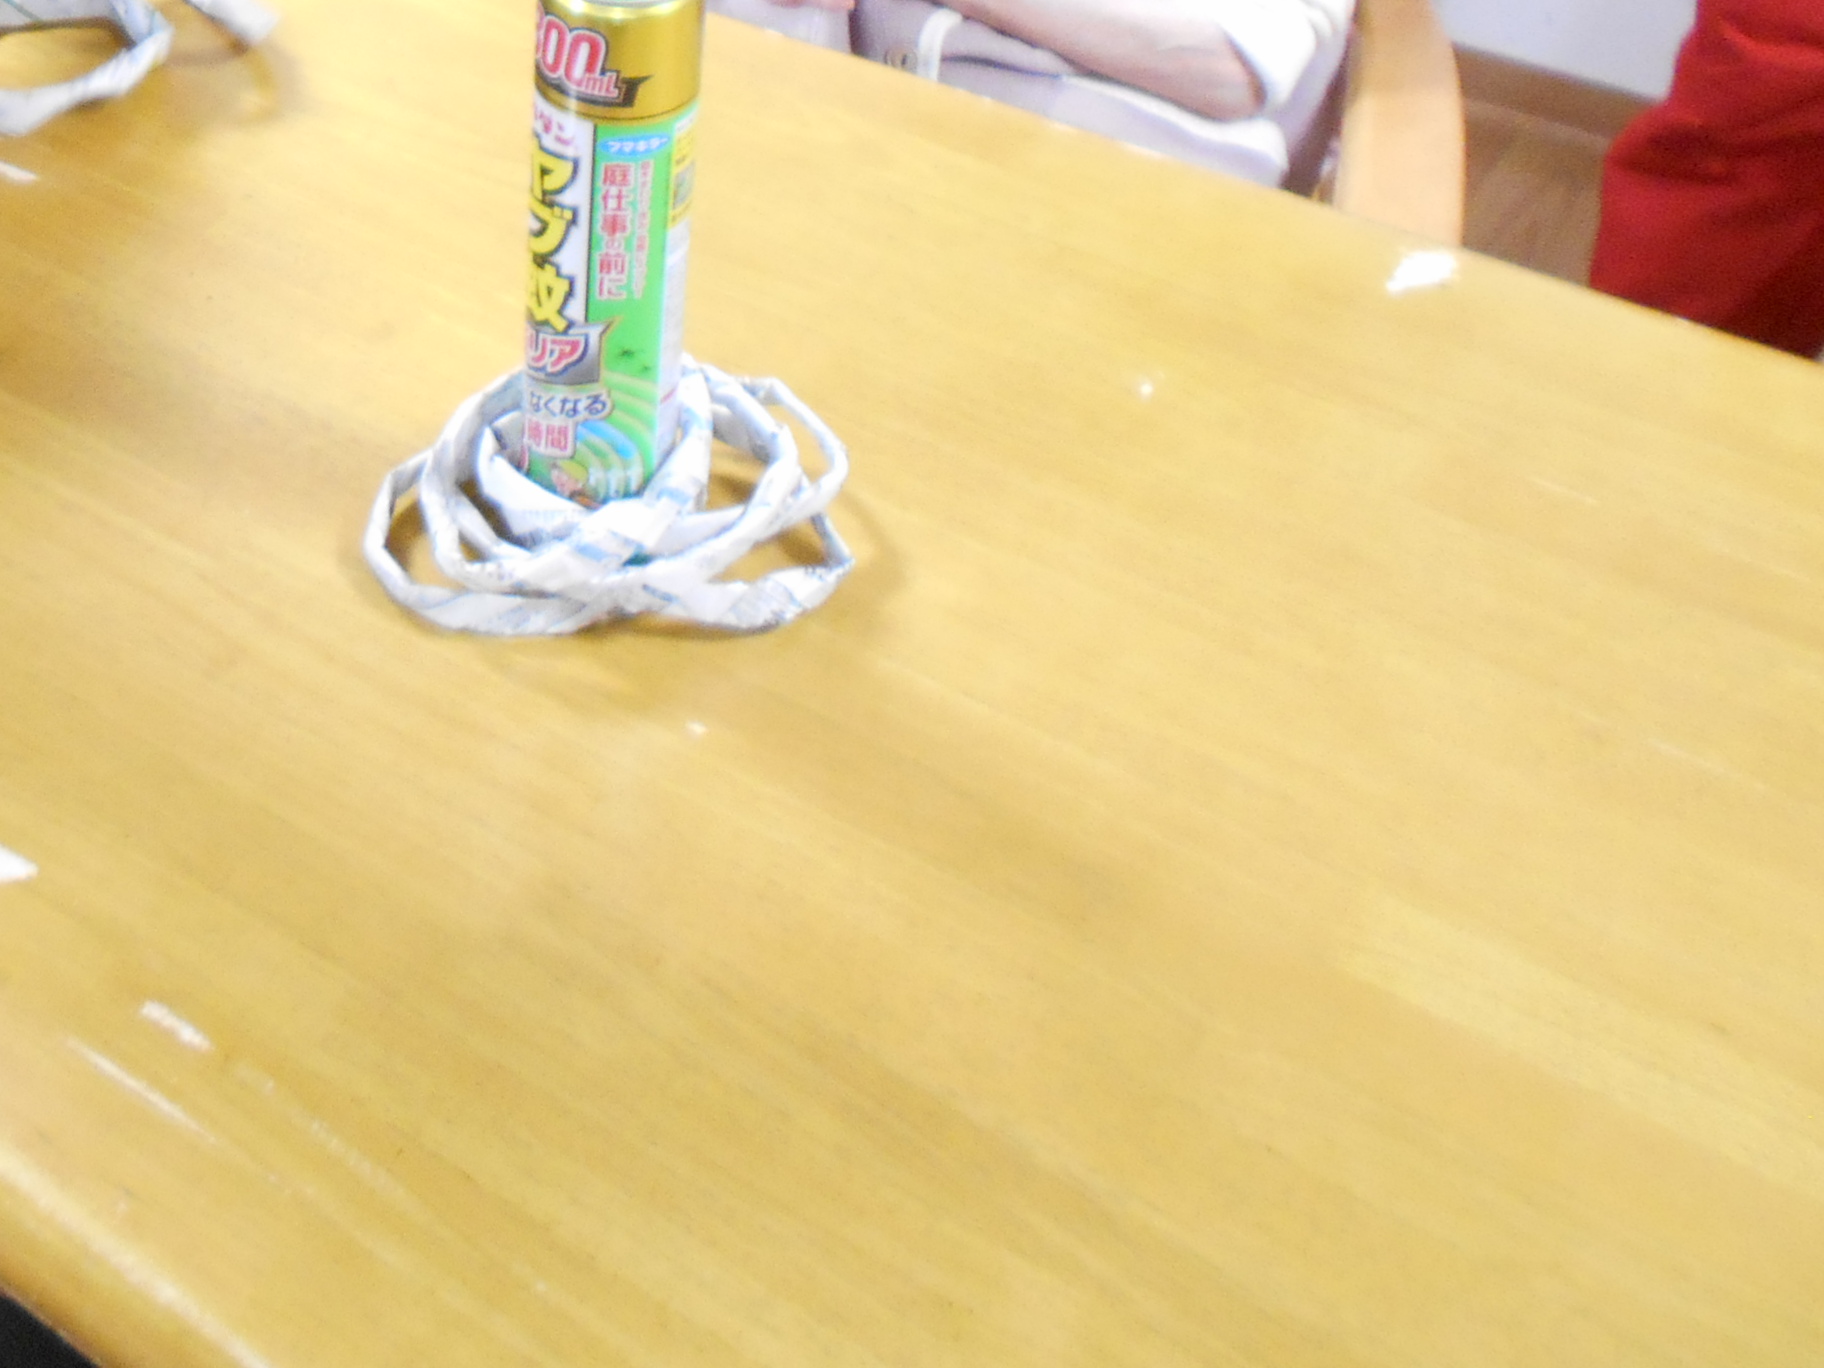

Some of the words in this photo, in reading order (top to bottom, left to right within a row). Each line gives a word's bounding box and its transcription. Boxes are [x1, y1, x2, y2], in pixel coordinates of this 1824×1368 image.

[599, 163, 633, 298] 庭仕事の前に
